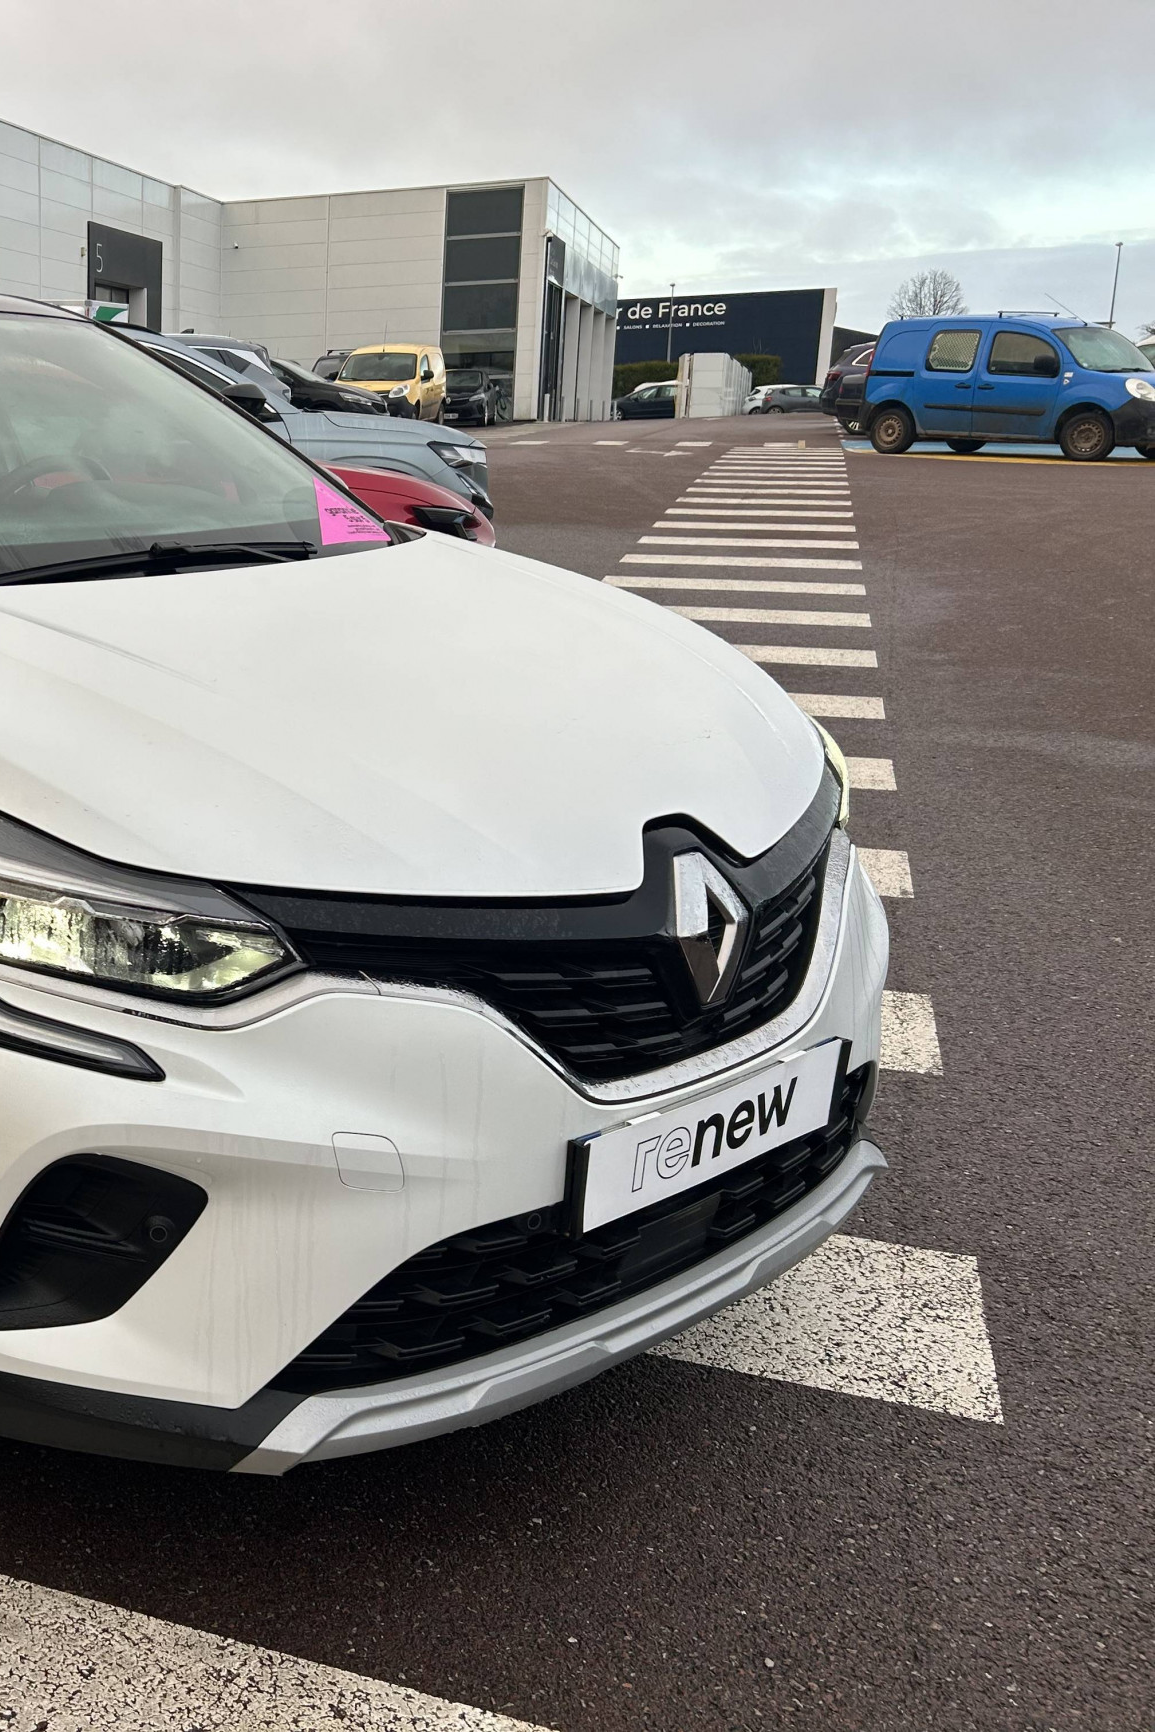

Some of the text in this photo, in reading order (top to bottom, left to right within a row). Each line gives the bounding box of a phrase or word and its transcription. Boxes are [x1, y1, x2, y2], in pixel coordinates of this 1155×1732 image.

[96, 243, 104, 273] 5
[627, 303, 653, 319] de
[658, 302, 727, 318] France
[631, 1075, 799, 1194] renew
